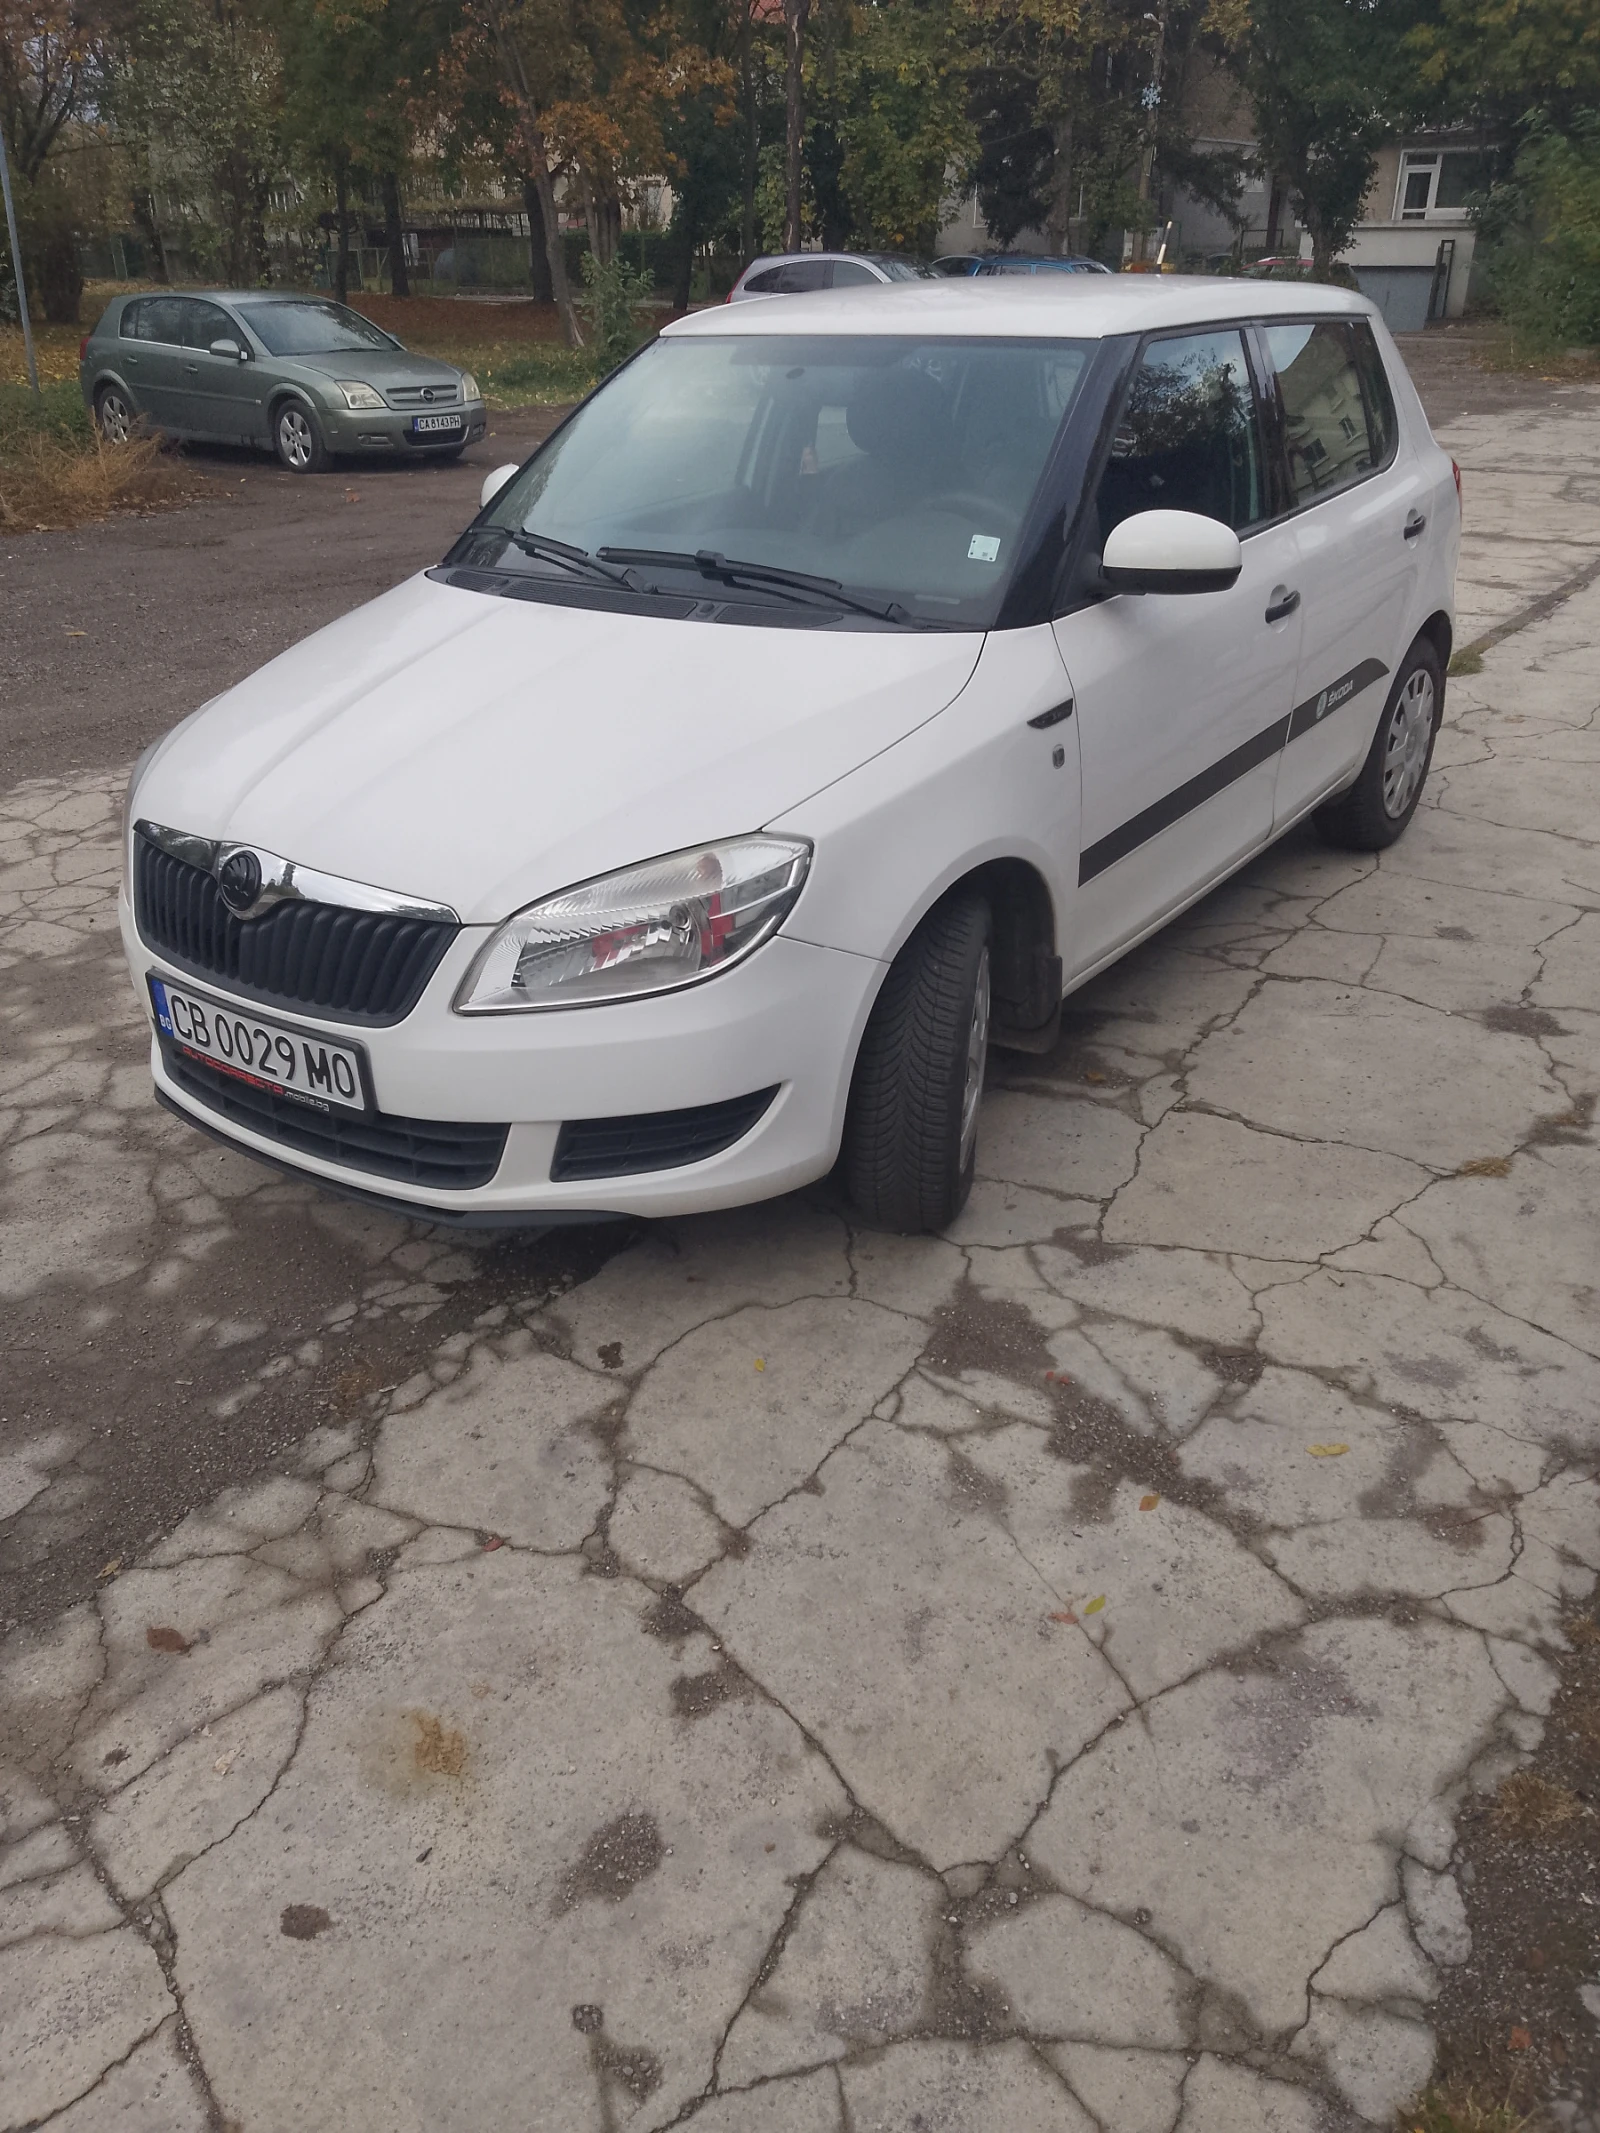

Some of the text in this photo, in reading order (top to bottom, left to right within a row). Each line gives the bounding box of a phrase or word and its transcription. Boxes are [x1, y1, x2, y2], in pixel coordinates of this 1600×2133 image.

[420, 419, 430, 430] CA
[431, 417, 449, 429] 8143
[450, 416, 460, 427] PH
[160, 1014, 173, 1030] BG
[171, 995, 356, 1099] CB 0029 MO
